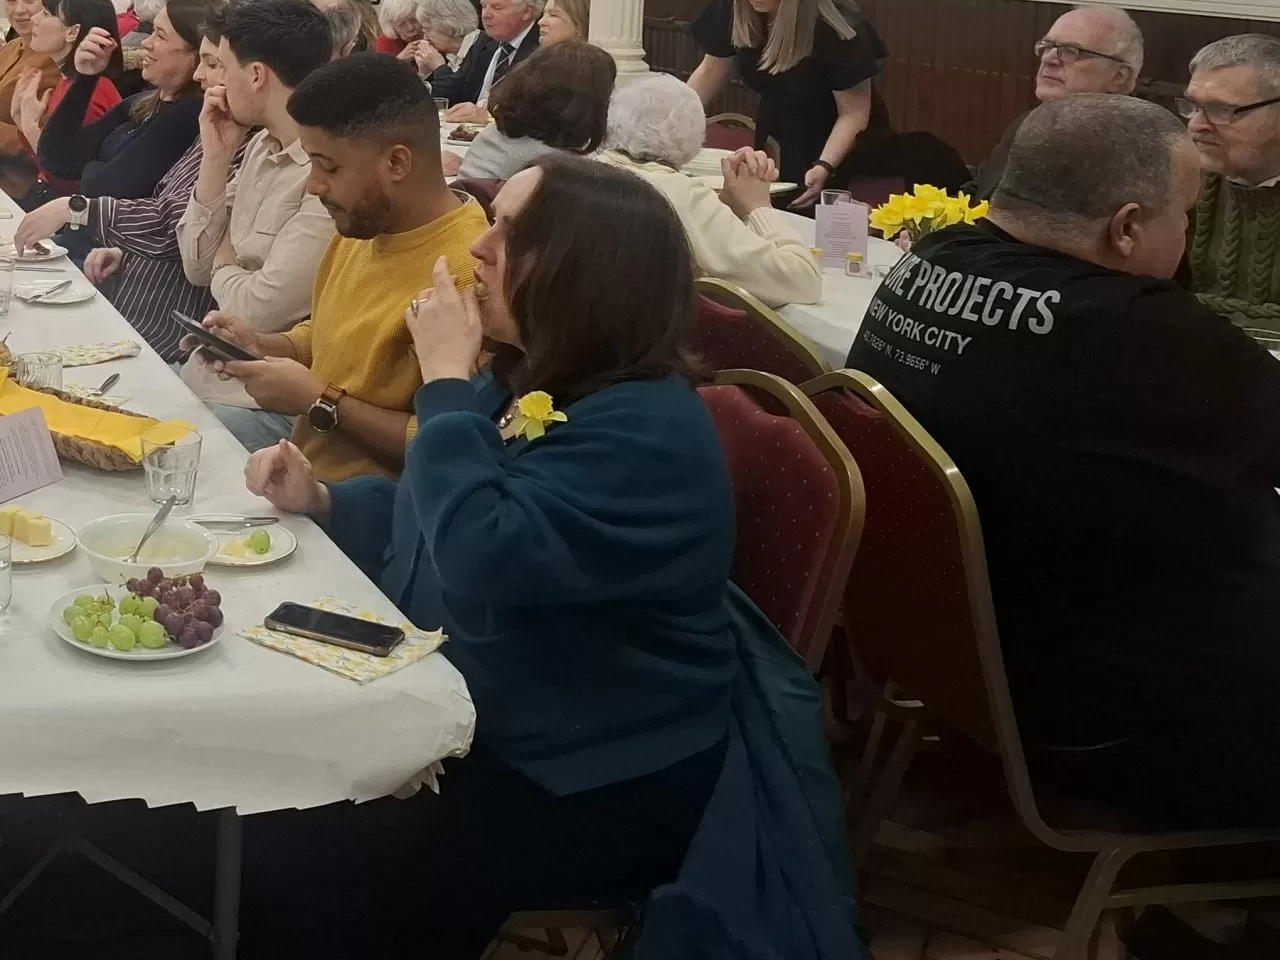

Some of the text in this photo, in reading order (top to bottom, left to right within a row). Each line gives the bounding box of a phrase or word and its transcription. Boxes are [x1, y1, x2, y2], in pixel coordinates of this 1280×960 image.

[906, 259, 1061, 335] PROJECTS
[885, 310, 926, 342] YORK
[924, 326, 973, 356] CITY
[930, 361, 941, 376] W
